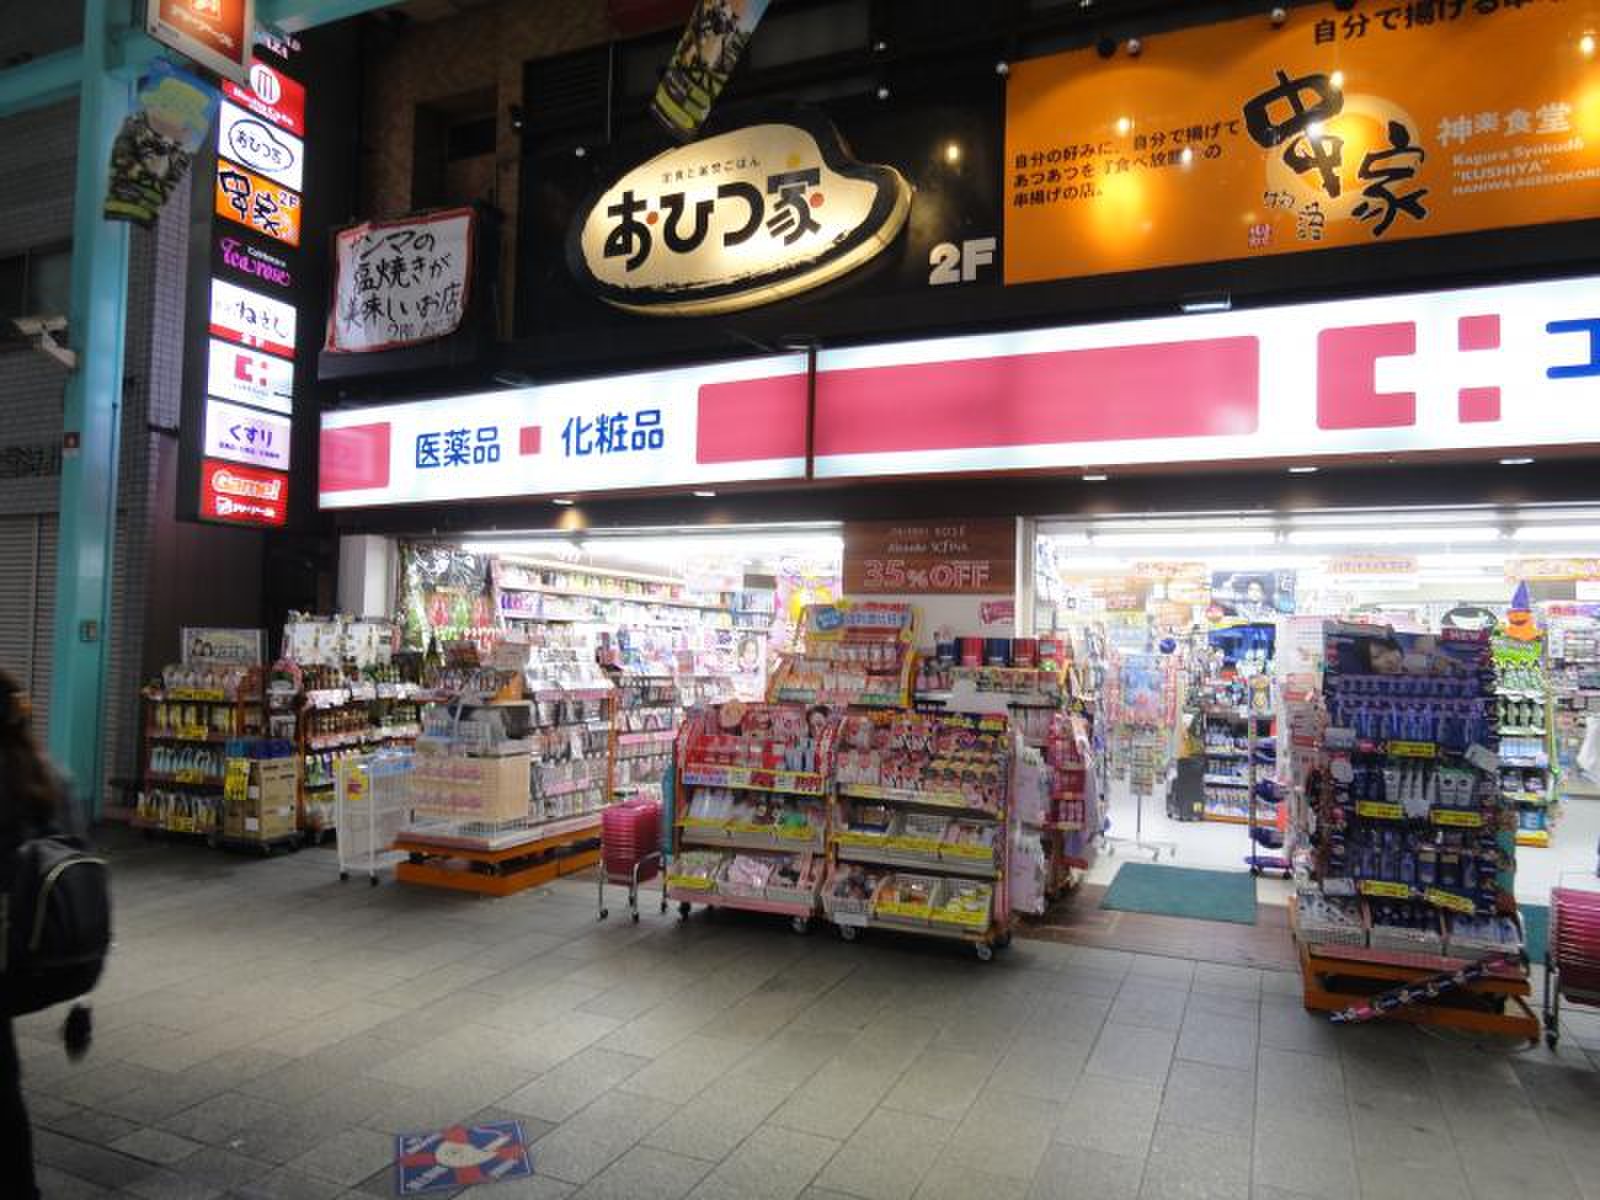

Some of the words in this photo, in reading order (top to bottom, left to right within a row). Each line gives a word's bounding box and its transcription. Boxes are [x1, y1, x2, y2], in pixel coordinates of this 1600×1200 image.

[602, 166, 822, 272] おひつ家
[929, 237, 997, 286] 2F
[229, 424, 273, 448] くすり
[415, 426, 501, 469] 医薬品
[561, 409, 665, 458] 化粧品
